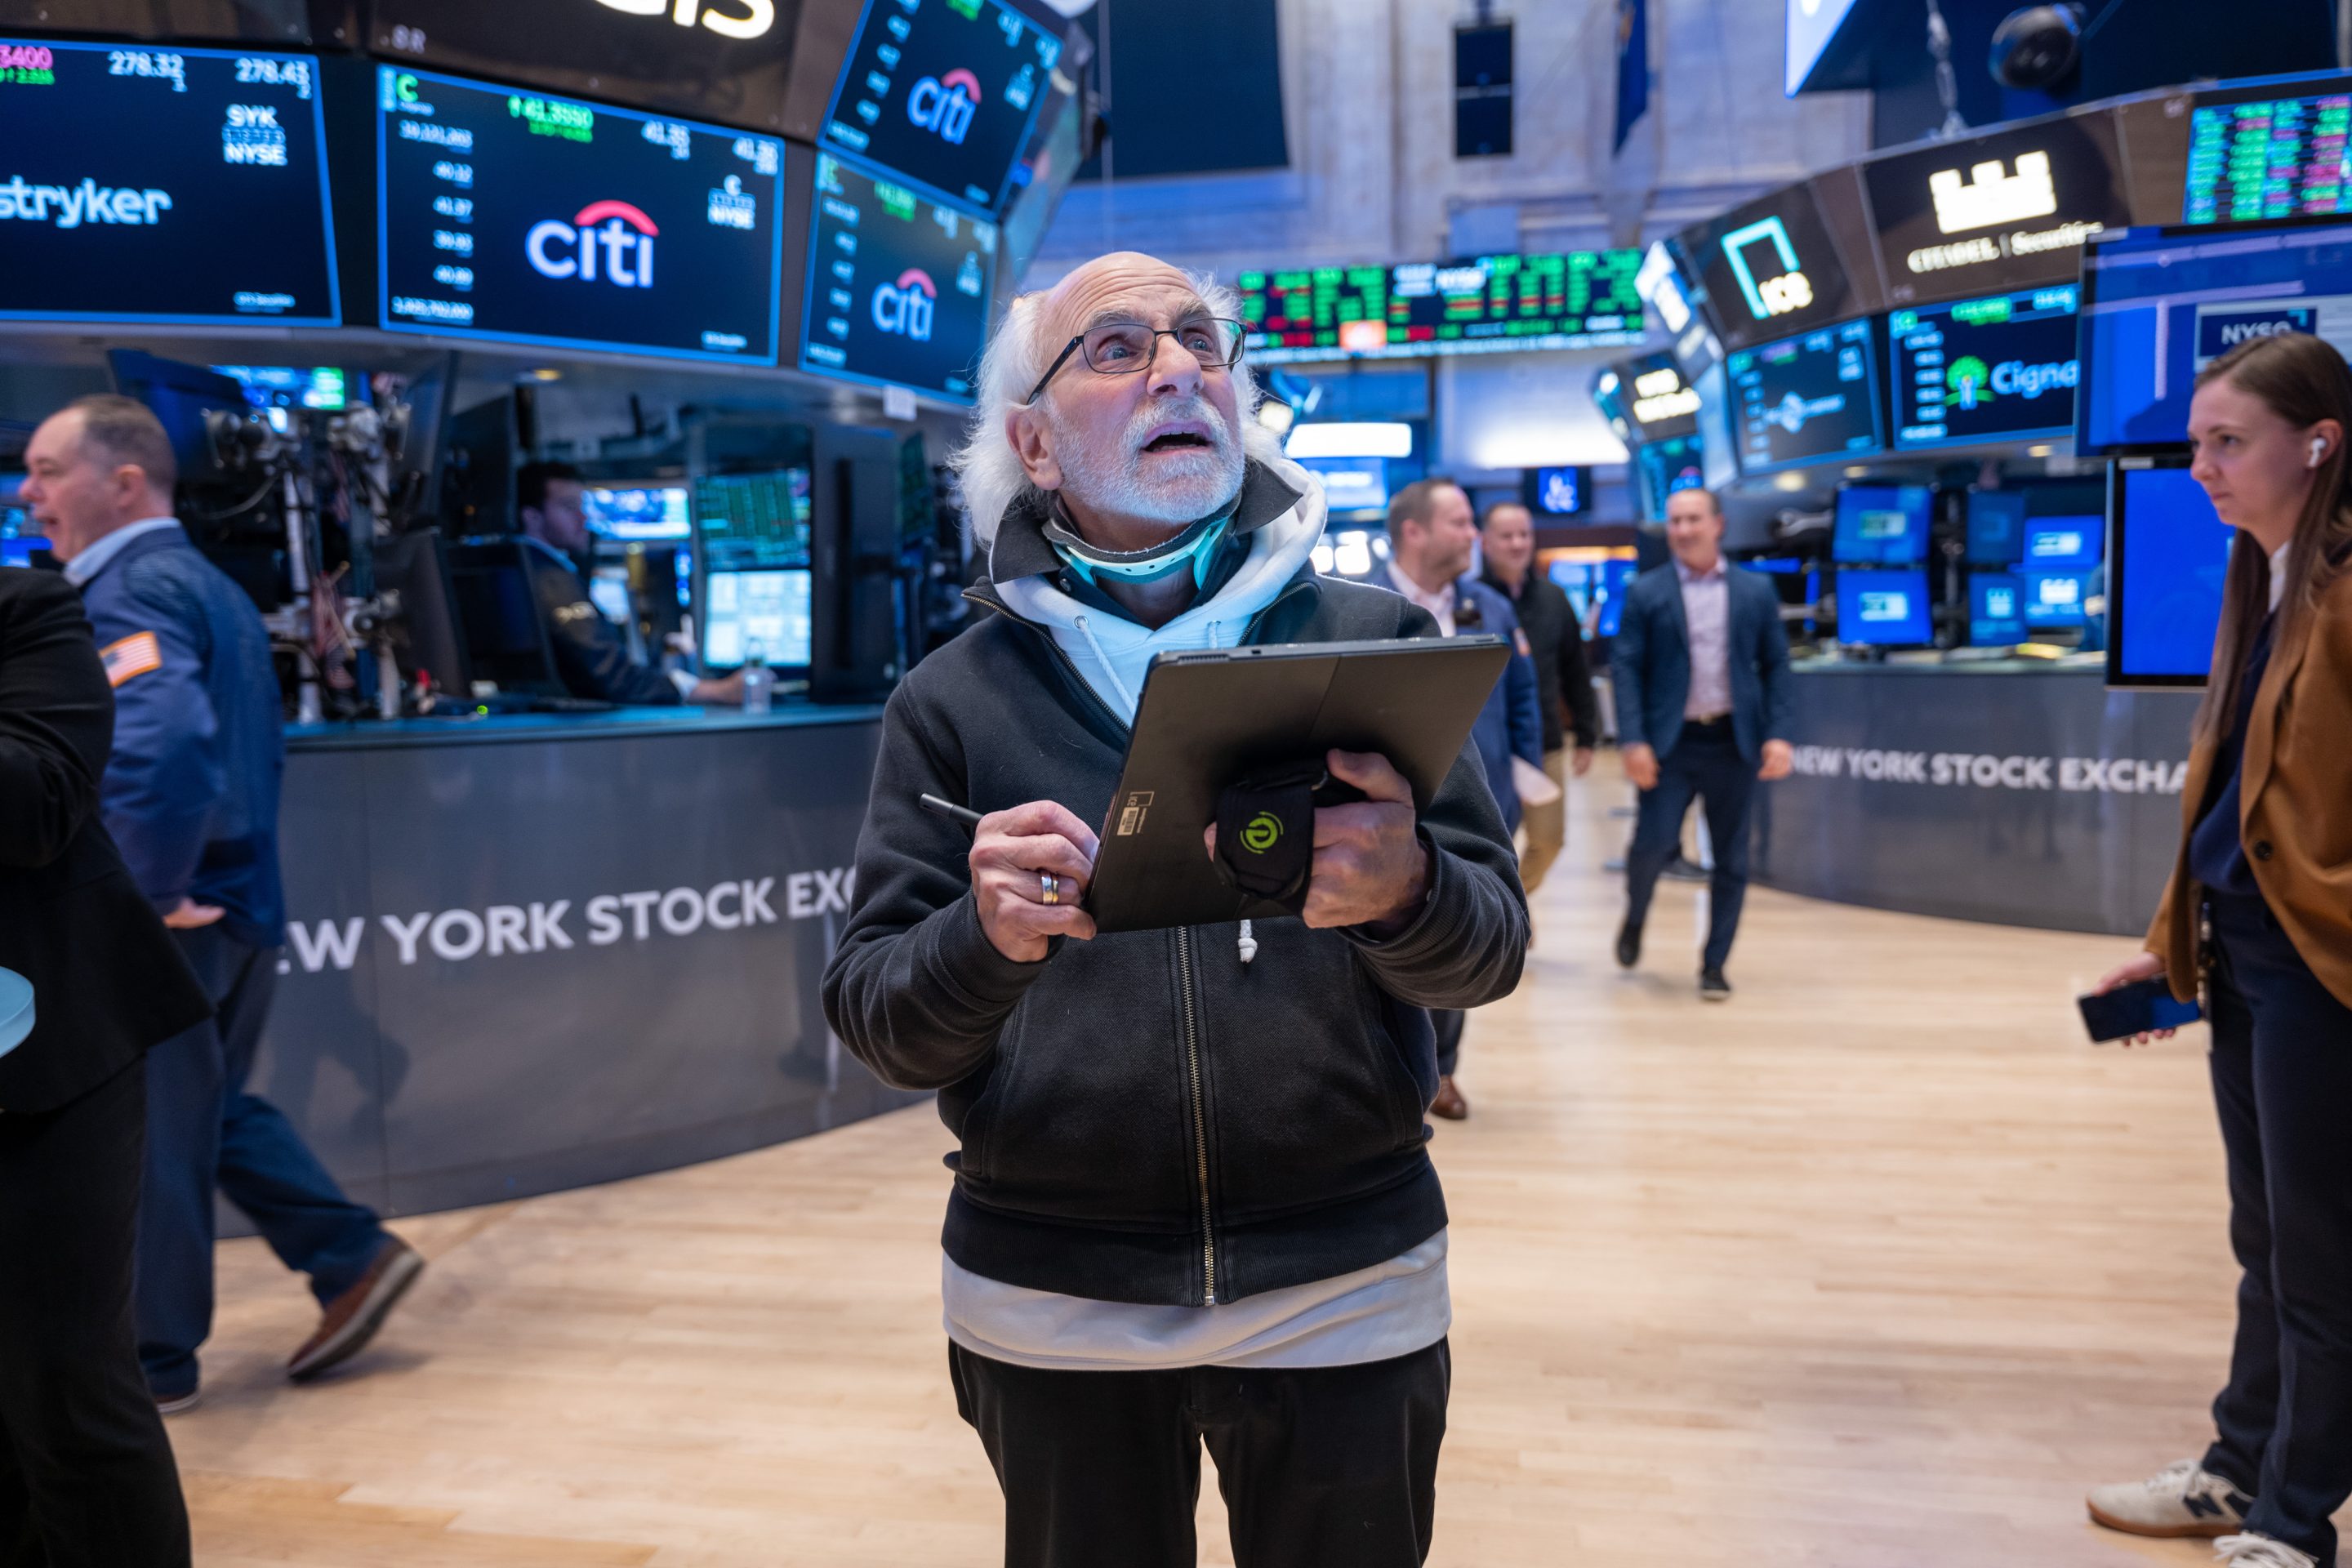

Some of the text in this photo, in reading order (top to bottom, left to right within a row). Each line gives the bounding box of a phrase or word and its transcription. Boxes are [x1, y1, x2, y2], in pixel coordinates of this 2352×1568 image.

[396, 73, 419, 103] C
[907, 76, 977, 145] citi
[225, 104, 278, 129] SYK
[223, 141, 288, 167] NYSE
[0, 174, 173, 229] stryker
[525, 216, 654, 288] citi
[871, 282, 934, 342] citi
[1845, 747, 1927, 783] YORK
[1931, 753, 2052, 791] STOCK
[381, 900, 574, 965] YORK
[586, 876, 777, 946] STOCK
